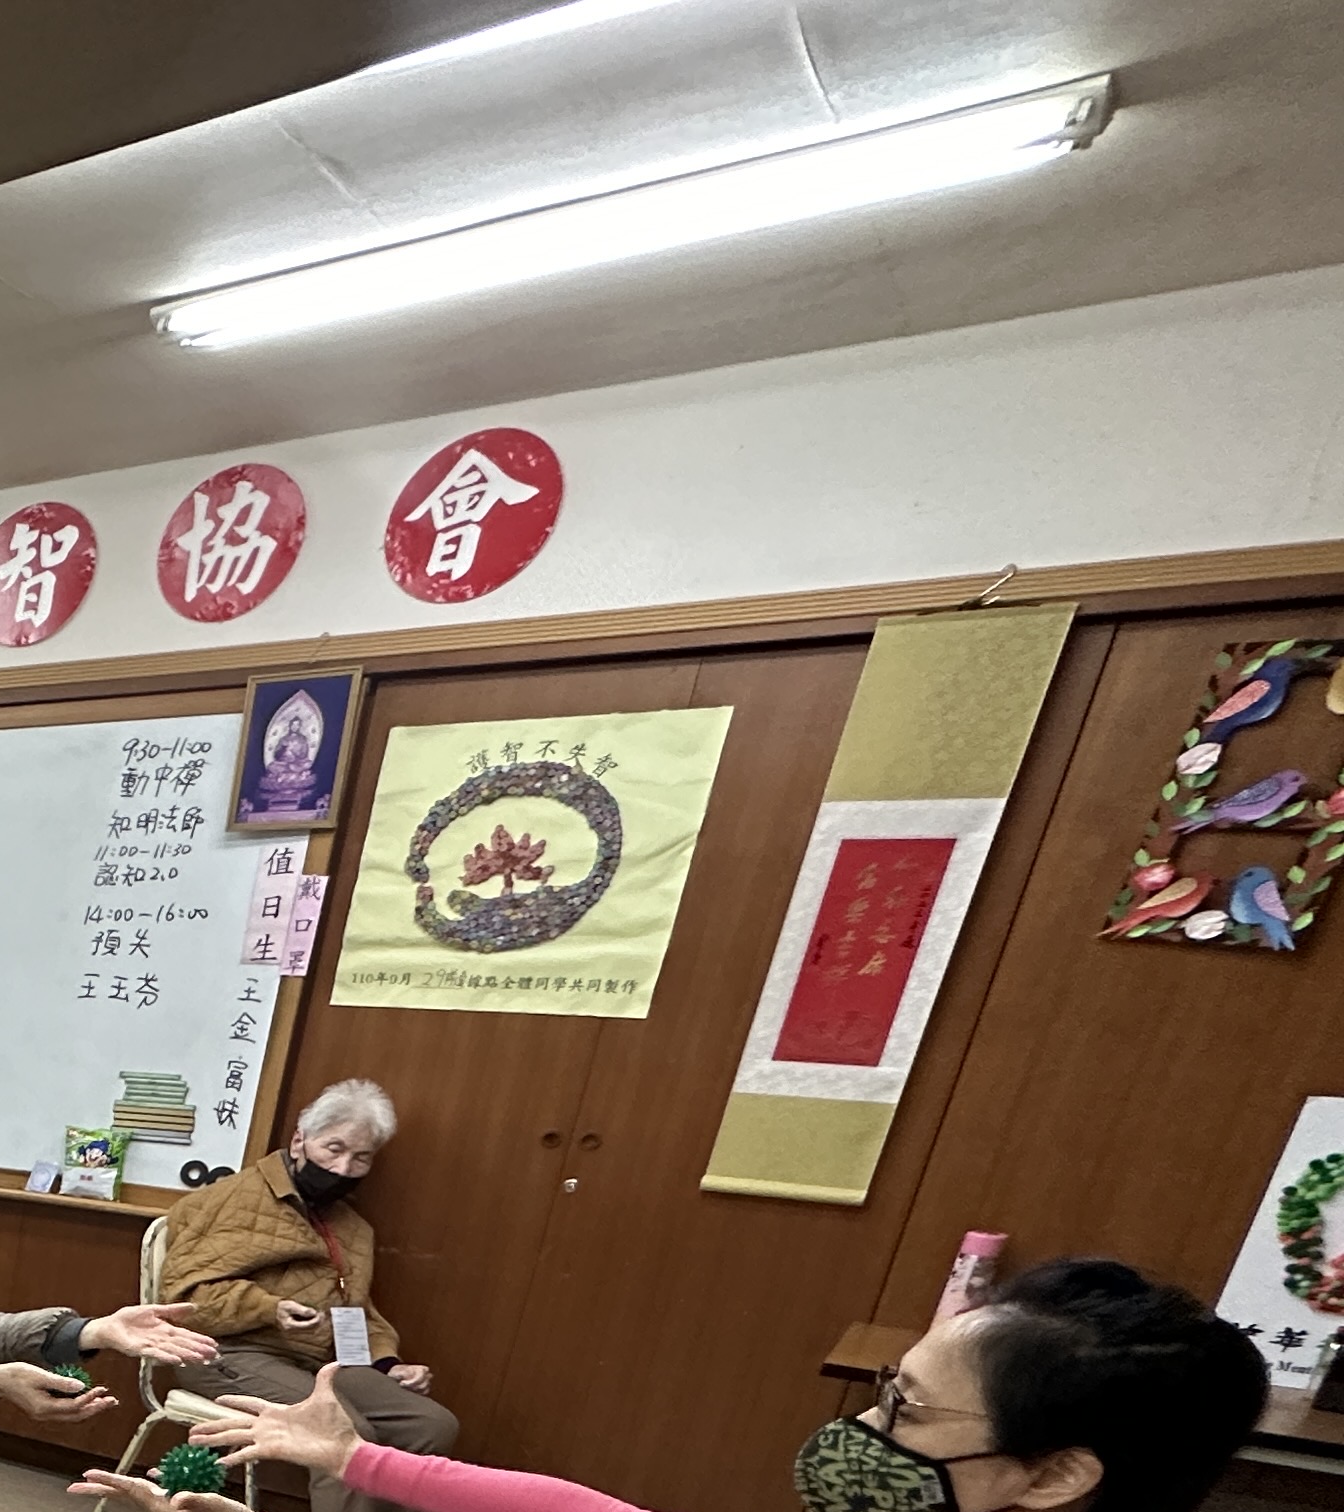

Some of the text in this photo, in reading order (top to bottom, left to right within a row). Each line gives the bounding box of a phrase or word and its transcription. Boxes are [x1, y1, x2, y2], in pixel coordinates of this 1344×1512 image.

[120, 758, 208, 798] 動中禪
[464, 738, 619, 779] 護智不失智
[107, 804, 205, 840] 知明法師
[83, 902, 209, 925] 14:00-16:00
[249, 847, 295, 962] 值日生
[282, 875, 321, 974] 戴口罩
[77, 973, 160, 1009] 王玉芬
